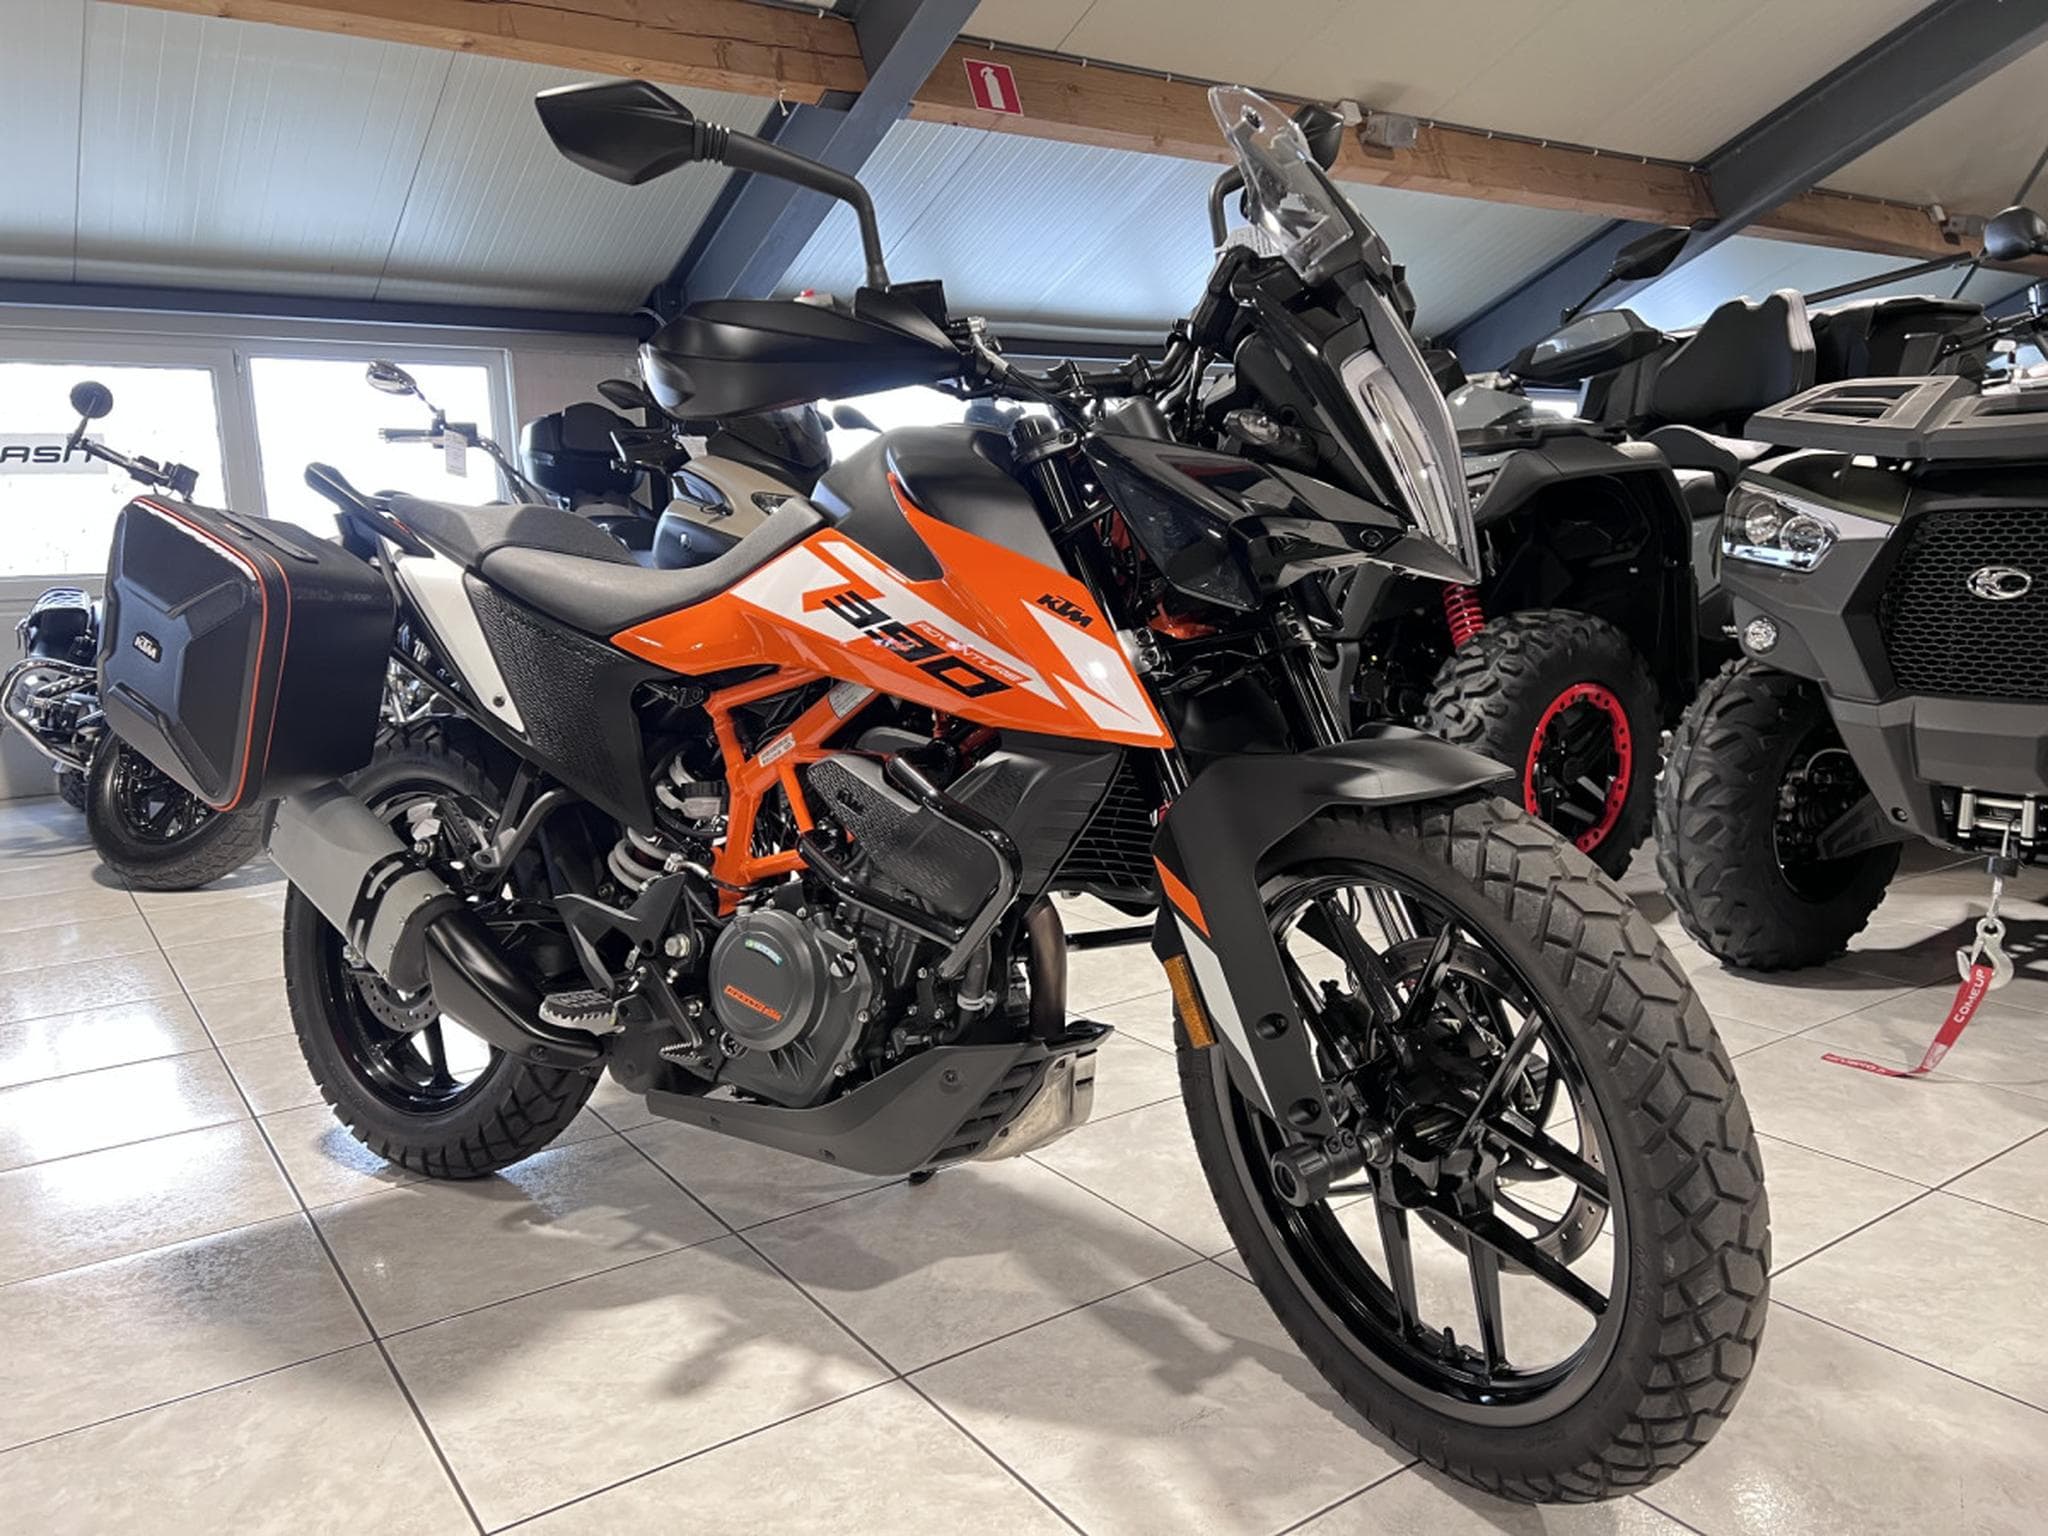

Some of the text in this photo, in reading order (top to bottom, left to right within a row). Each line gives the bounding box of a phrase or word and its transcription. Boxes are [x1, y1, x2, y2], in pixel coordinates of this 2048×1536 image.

[1036, 593, 1093, 629] KTM
[134, 634, 158, 660] KTM
[821, 589, 1013, 698] 390
[1953, 968, 1985, 1024] COMEUP
